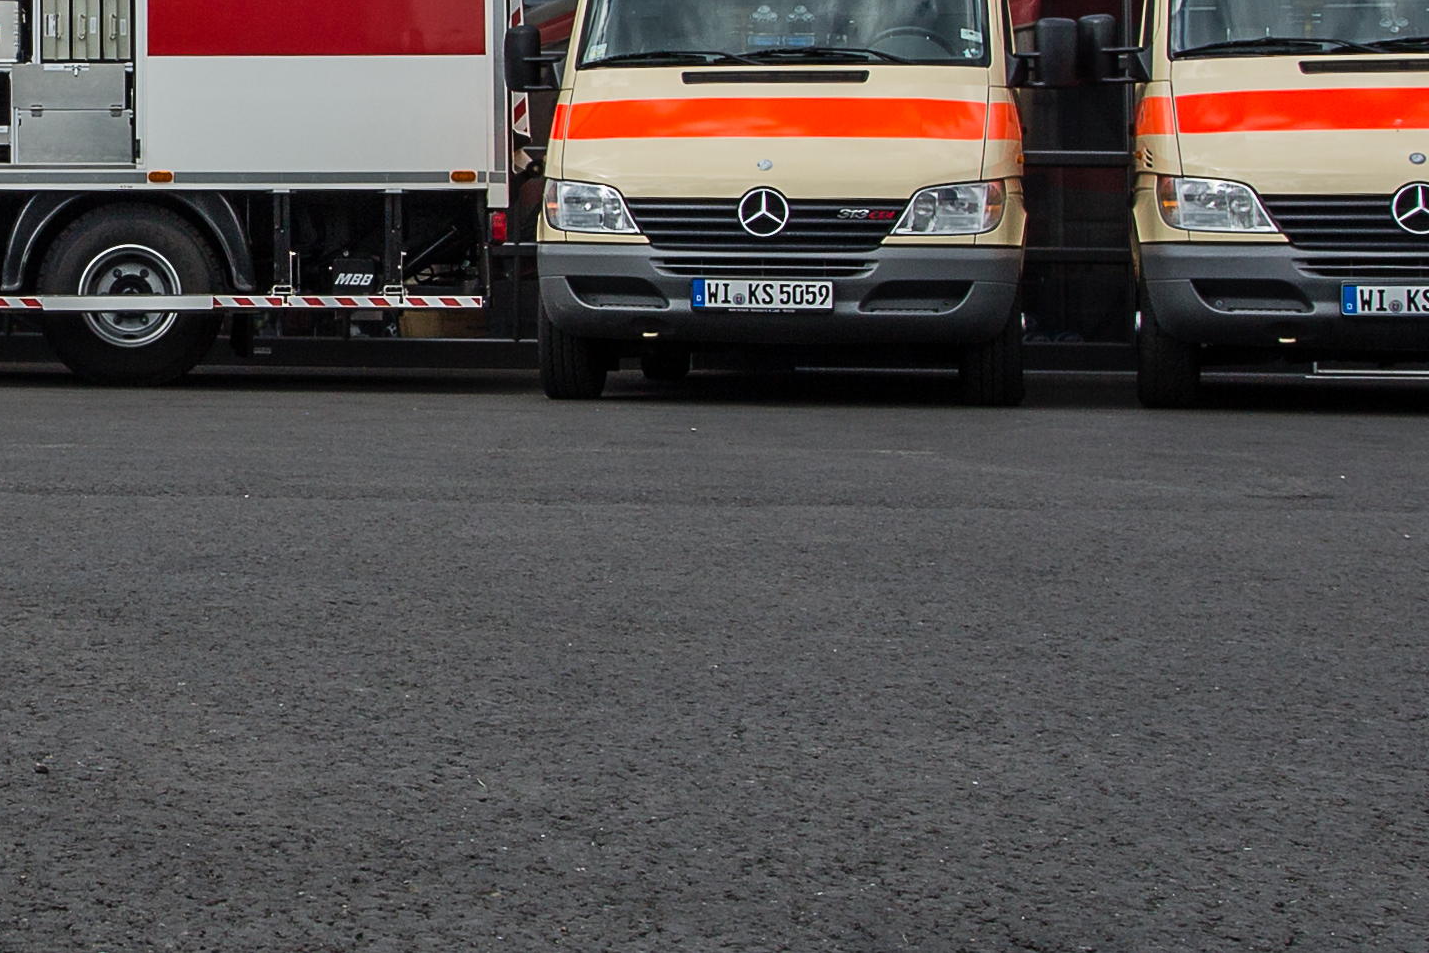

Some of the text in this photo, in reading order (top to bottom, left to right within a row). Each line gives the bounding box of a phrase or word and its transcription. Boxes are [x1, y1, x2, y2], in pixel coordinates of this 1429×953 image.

[335, 273, 374, 285] MBB
[707, 283, 731, 304] WI
[748, 283, 774, 305] KS
[779, 284, 830, 305] 5059
[1360, 289, 1387, 311] WI
